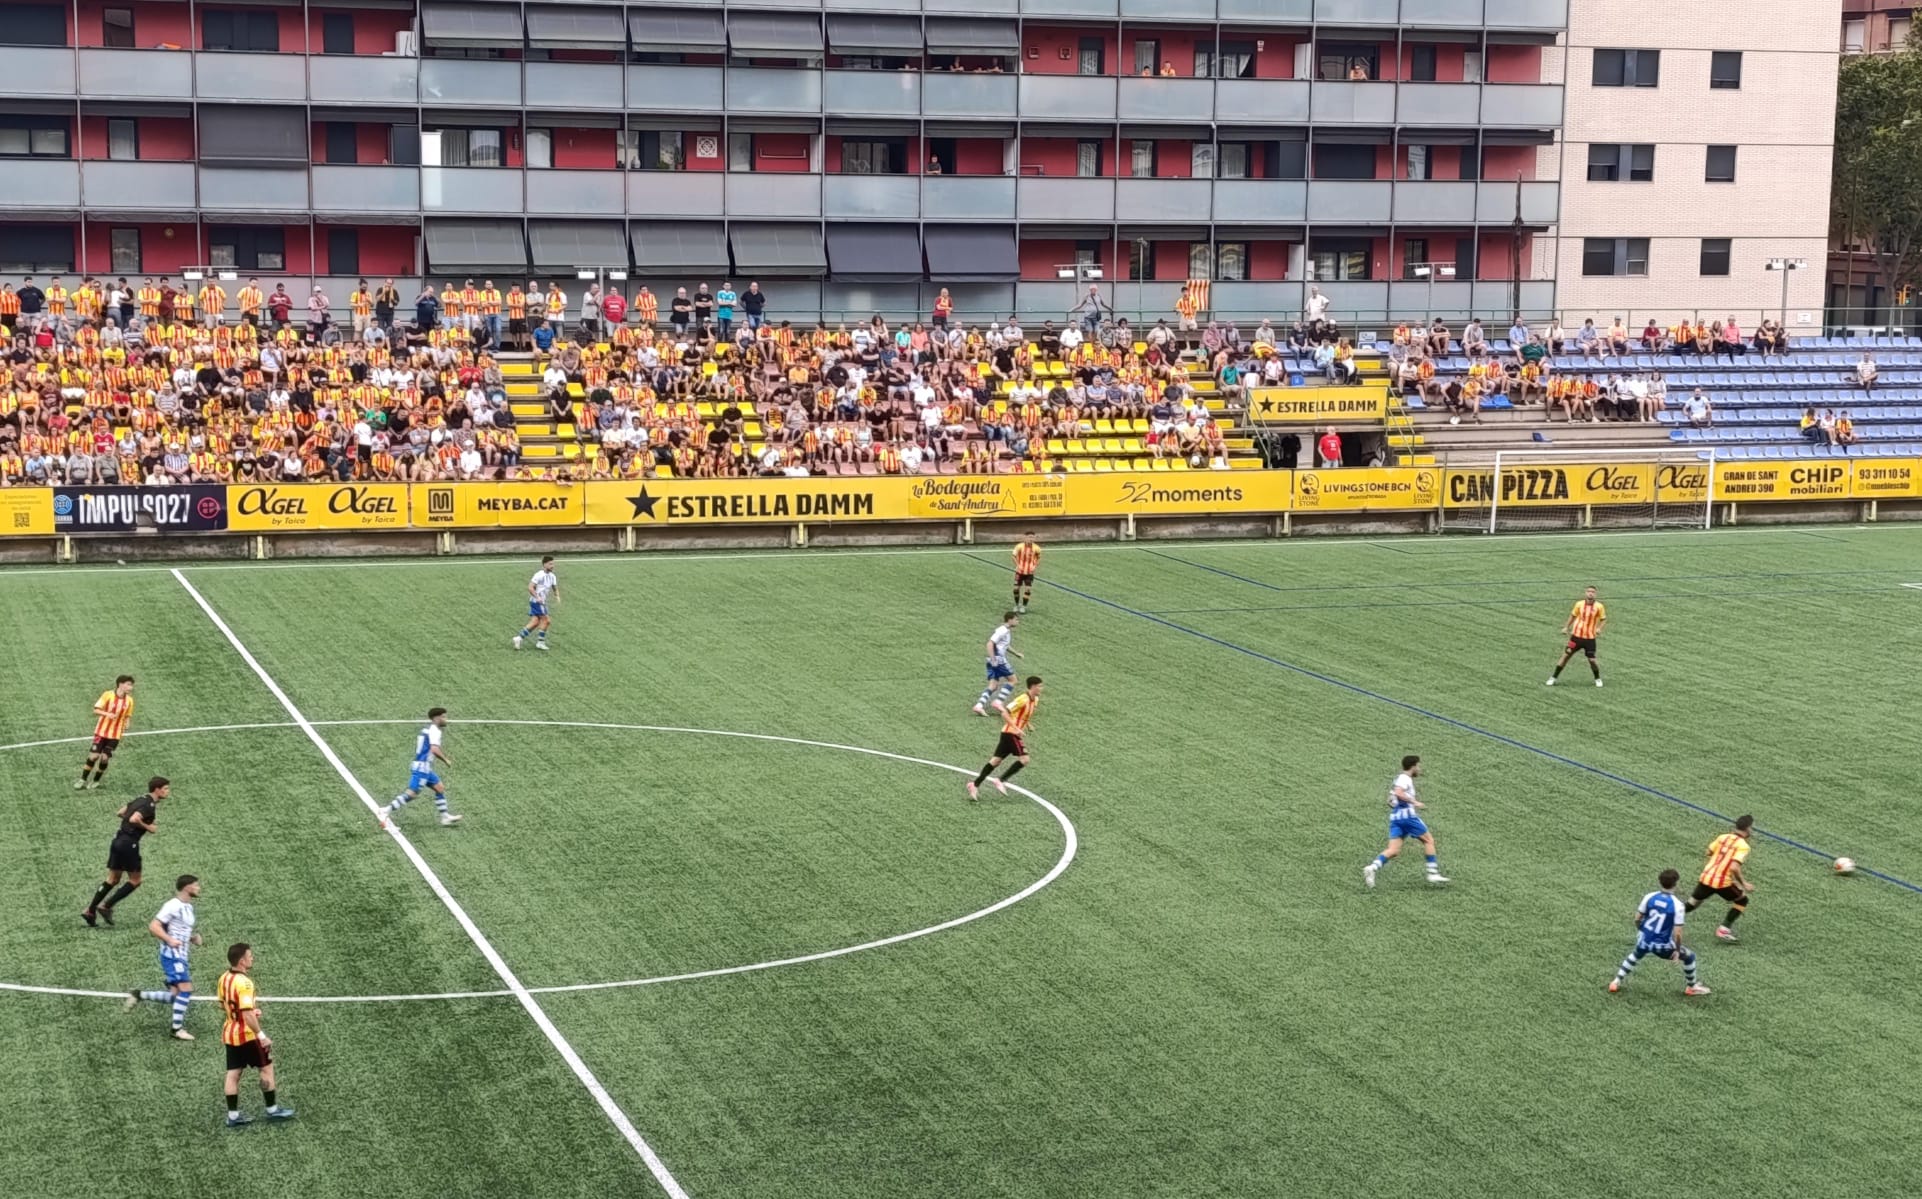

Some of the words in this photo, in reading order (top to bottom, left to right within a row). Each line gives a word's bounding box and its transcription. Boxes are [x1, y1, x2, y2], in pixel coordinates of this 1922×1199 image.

[1277, 400, 1335, 413] ESTRELLA
[1339, 400, 1377, 412] DAMM
[1724, 471, 1745, 481] GRAN
[1746, 471, 1757, 481] DE
[1758, 470, 1779, 480] SANT
[1859, 469, 1871, 479] 93
[1872, 469, 1886, 479] 311
[1888, 469, 1897, 479] 10
[1899, 468, 1910, 479] 54
[923, 479, 1000, 499] Bodegueta
[1451, 474, 1495, 502] CAN
[1501, 469, 1569, 500] PIZZA
[1725, 484, 1756, 494] ANDREU
[1758, 483, 1774, 493] 390
[1790, 484, 1843, 494] mobiliari
[478, 497, 568, 511] MEYBA.CAT
[667, 494, 788, 518] ESTRELLA
[796, 493, 873, 516] DAMM
[937, 499, 960, 510] Sant
[1644, 909, 1667, 934] 21
